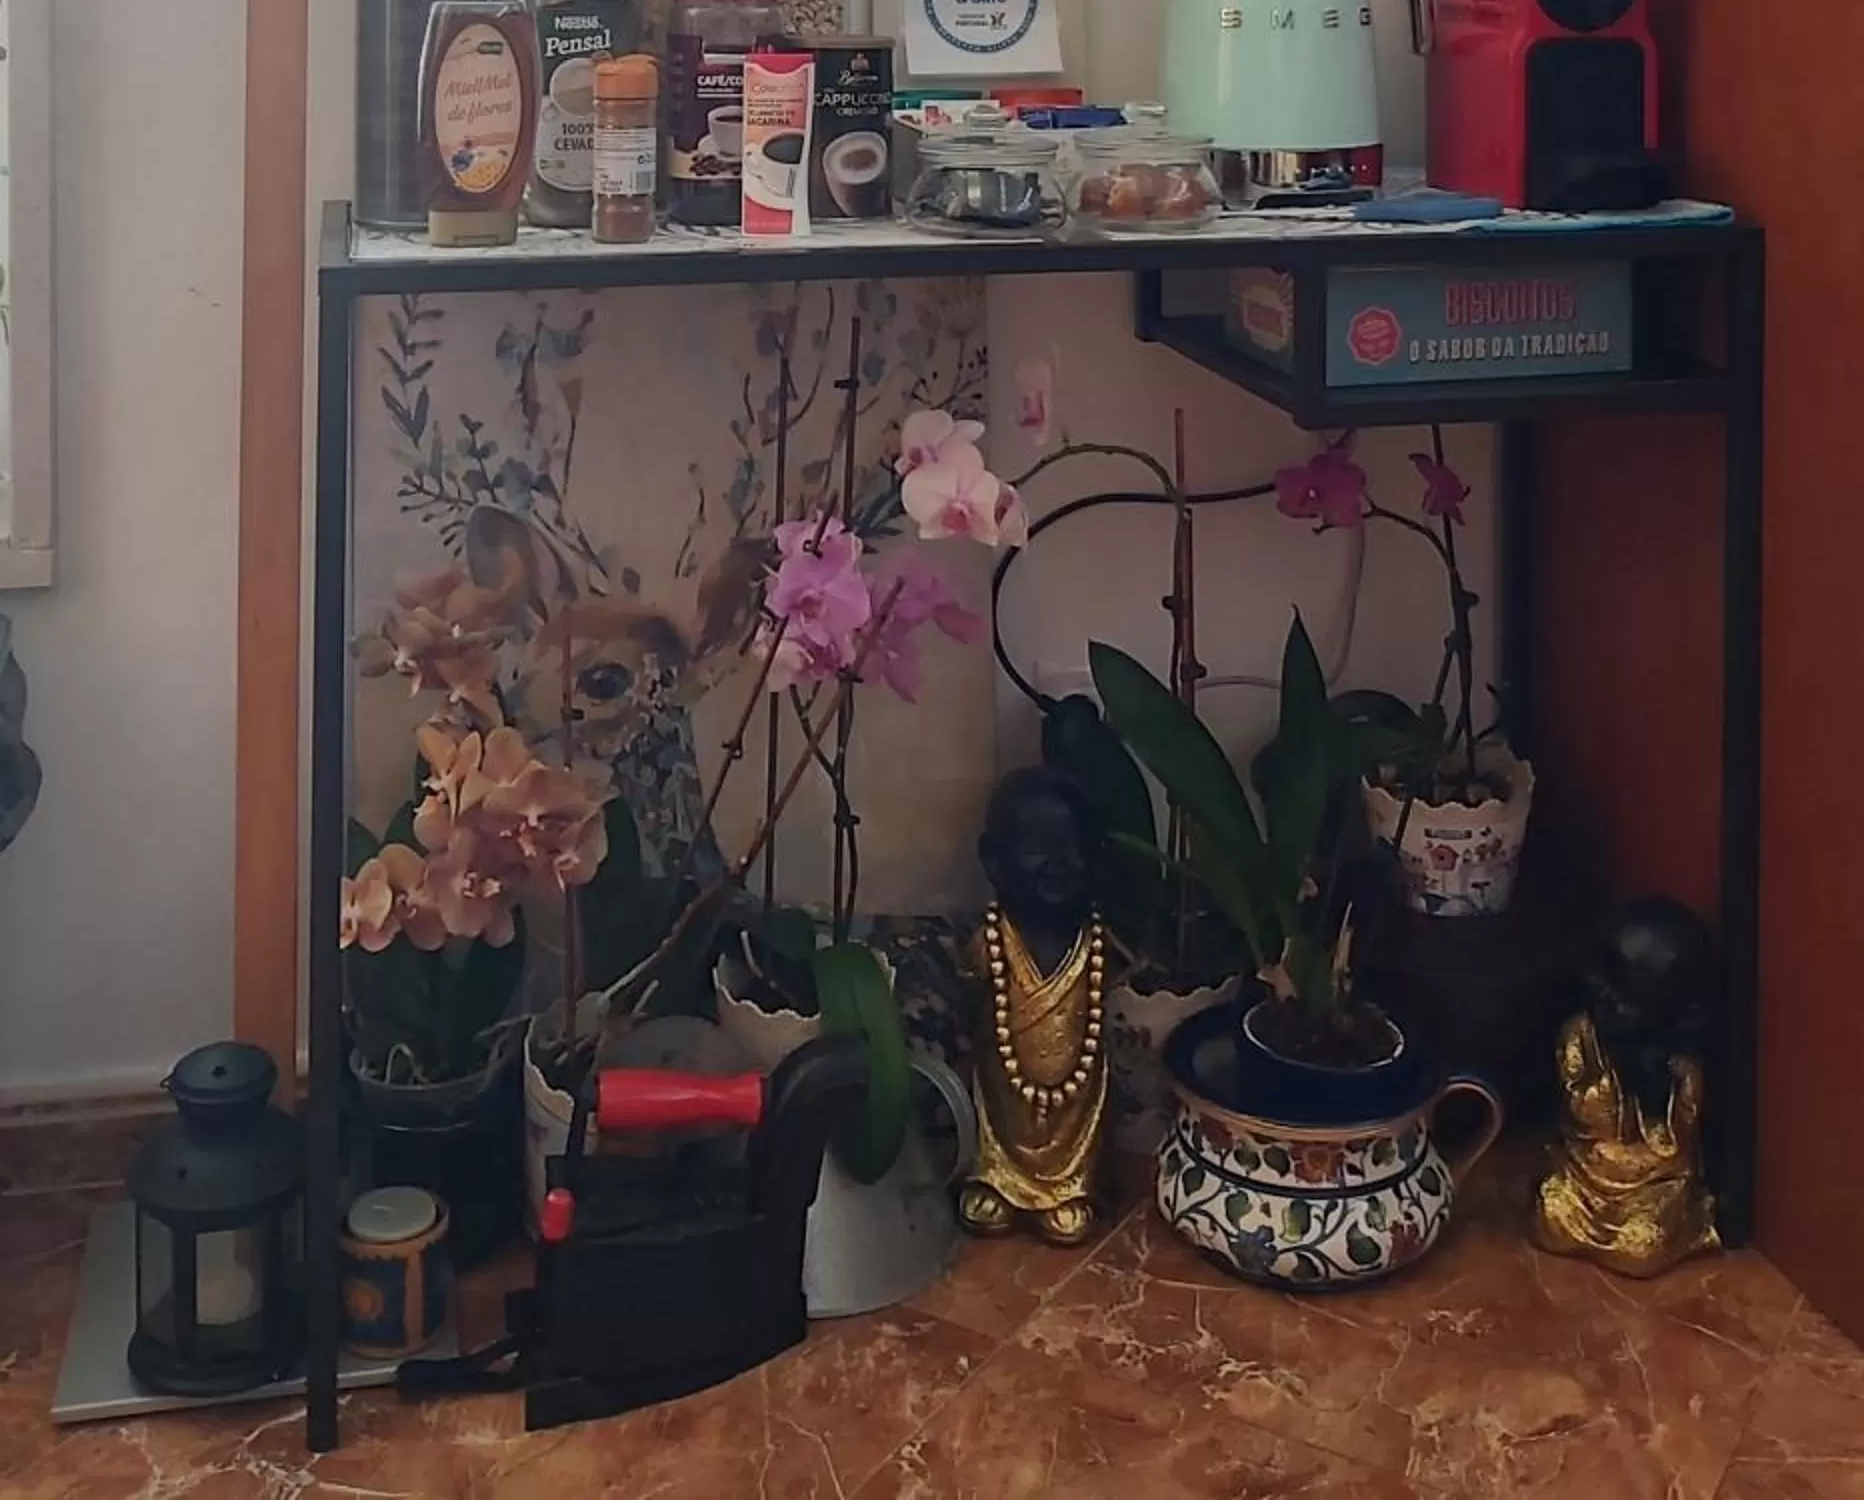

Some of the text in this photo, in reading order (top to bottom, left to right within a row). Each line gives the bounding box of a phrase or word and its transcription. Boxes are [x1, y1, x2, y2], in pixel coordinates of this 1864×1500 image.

[1220, 7, 1372, 29] SMEG
[544, 30, 612, 57] Pensal
[697, 73, 744, 87] CAFÉ/CO
[554, 137, 594, 151] CEVAD
[1445, 279, 1577, 327] BISCOITOS
[1409, 340, 1419, 363] O
[1426, 337, 1486, 362] SABOR
[1491, 336, 1515, 360] DA
